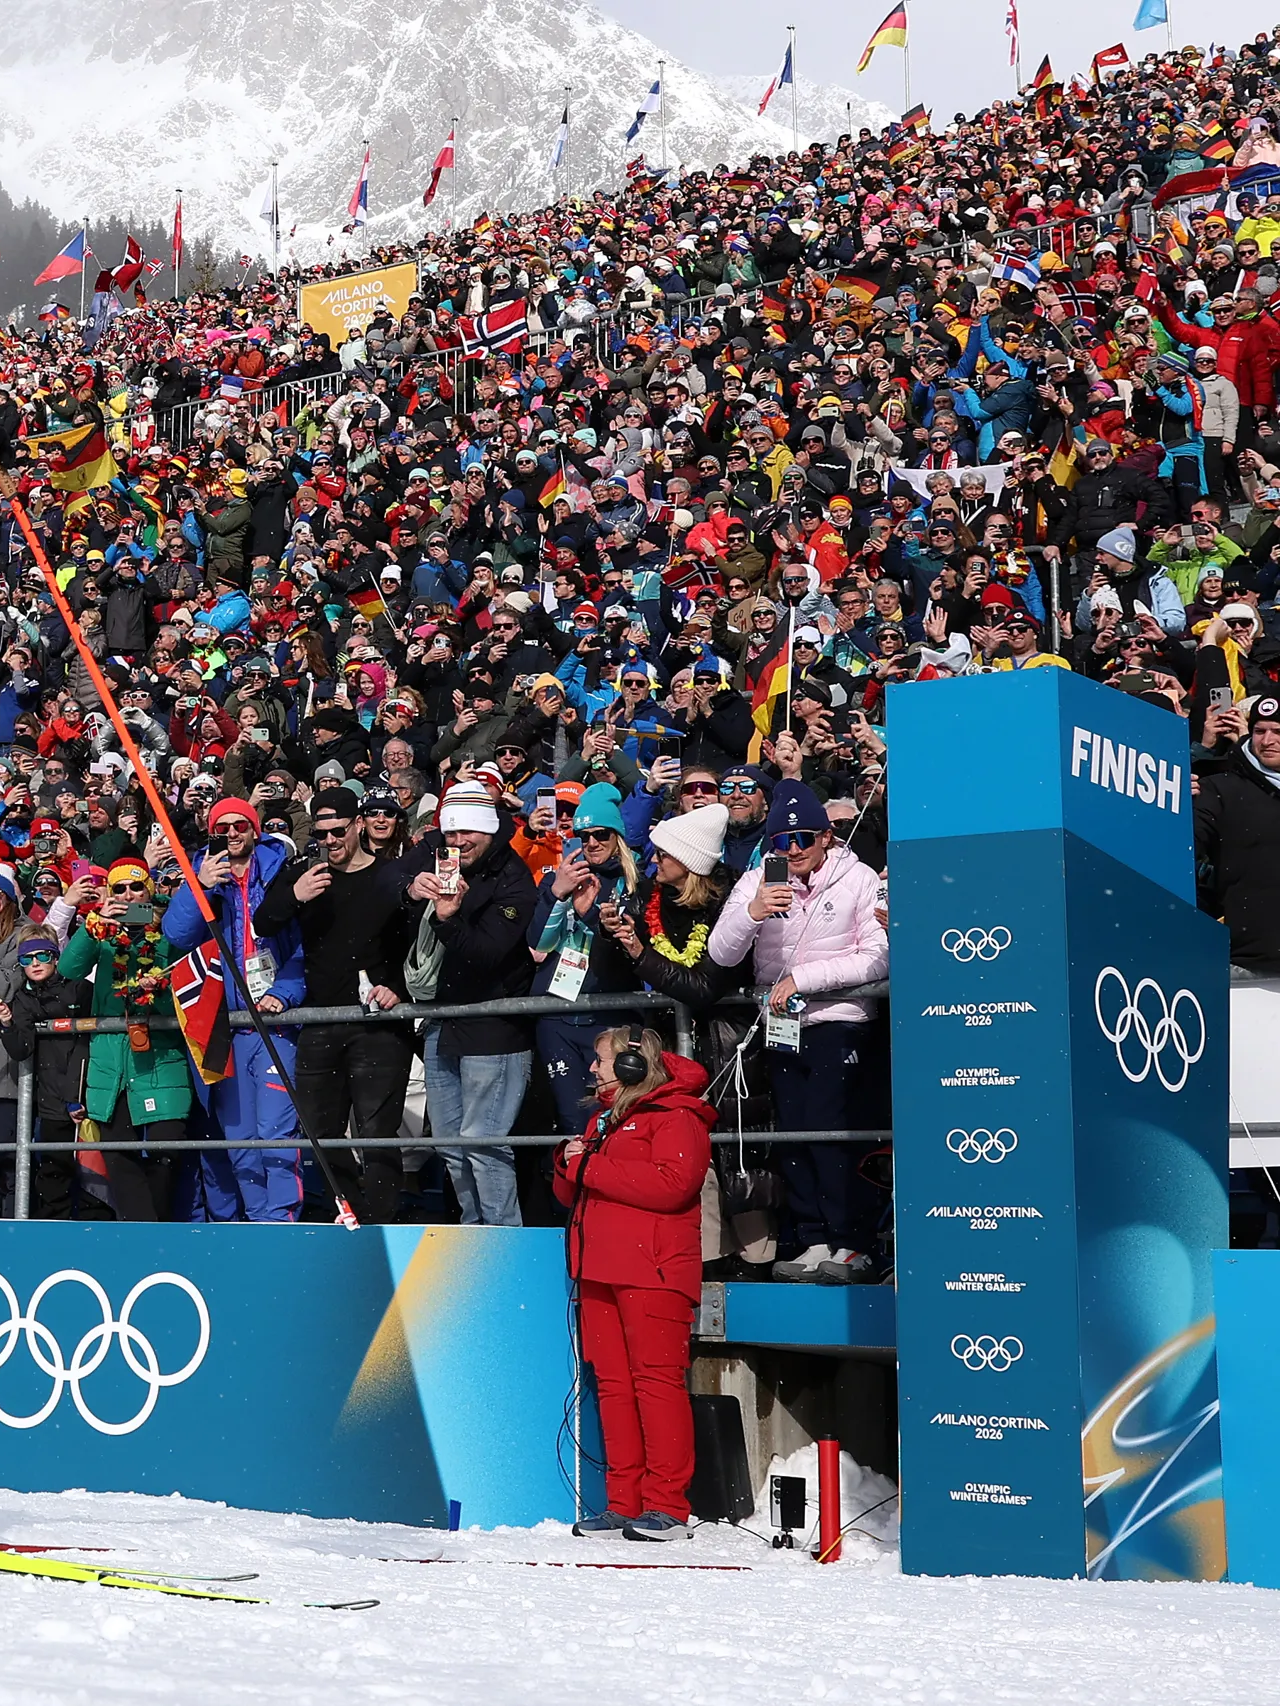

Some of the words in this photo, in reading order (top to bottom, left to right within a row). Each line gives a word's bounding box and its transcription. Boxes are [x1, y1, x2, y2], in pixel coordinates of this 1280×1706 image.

[320, 280, 383, 305] MILANO
[331, 293, 396, 316] CORTINA
[1072, 727, 1181, 814] FINISH
[921, 1004, 977, 1016] MILANO
[977, 1002, 1037, 1014] CORTINA
[965, 1015, 992, 1026] 2026
[955, 1068, 1000, 1078] OLYMPIC
[941, 1076, 978, 1087] WINTER
[926, 1207, 983, 1218] MILANO
[984, 1207, 1044, 1219] CORTINA
[970, 1219, 998, 1230] 2026
[960, 1272, 1006, 1282] OLYMPIC
[945, 1281, 984, 1291] WINTER
[930, 1413, 988, 1427] MILANO
[988, 1416, 1050, 1431] CORTINA
[974, 1428, 1004, 1440] 2026
[965, 1482, 1011, 1494] OLYMPIC
[949, 1490, 989, 1503] WINTER
